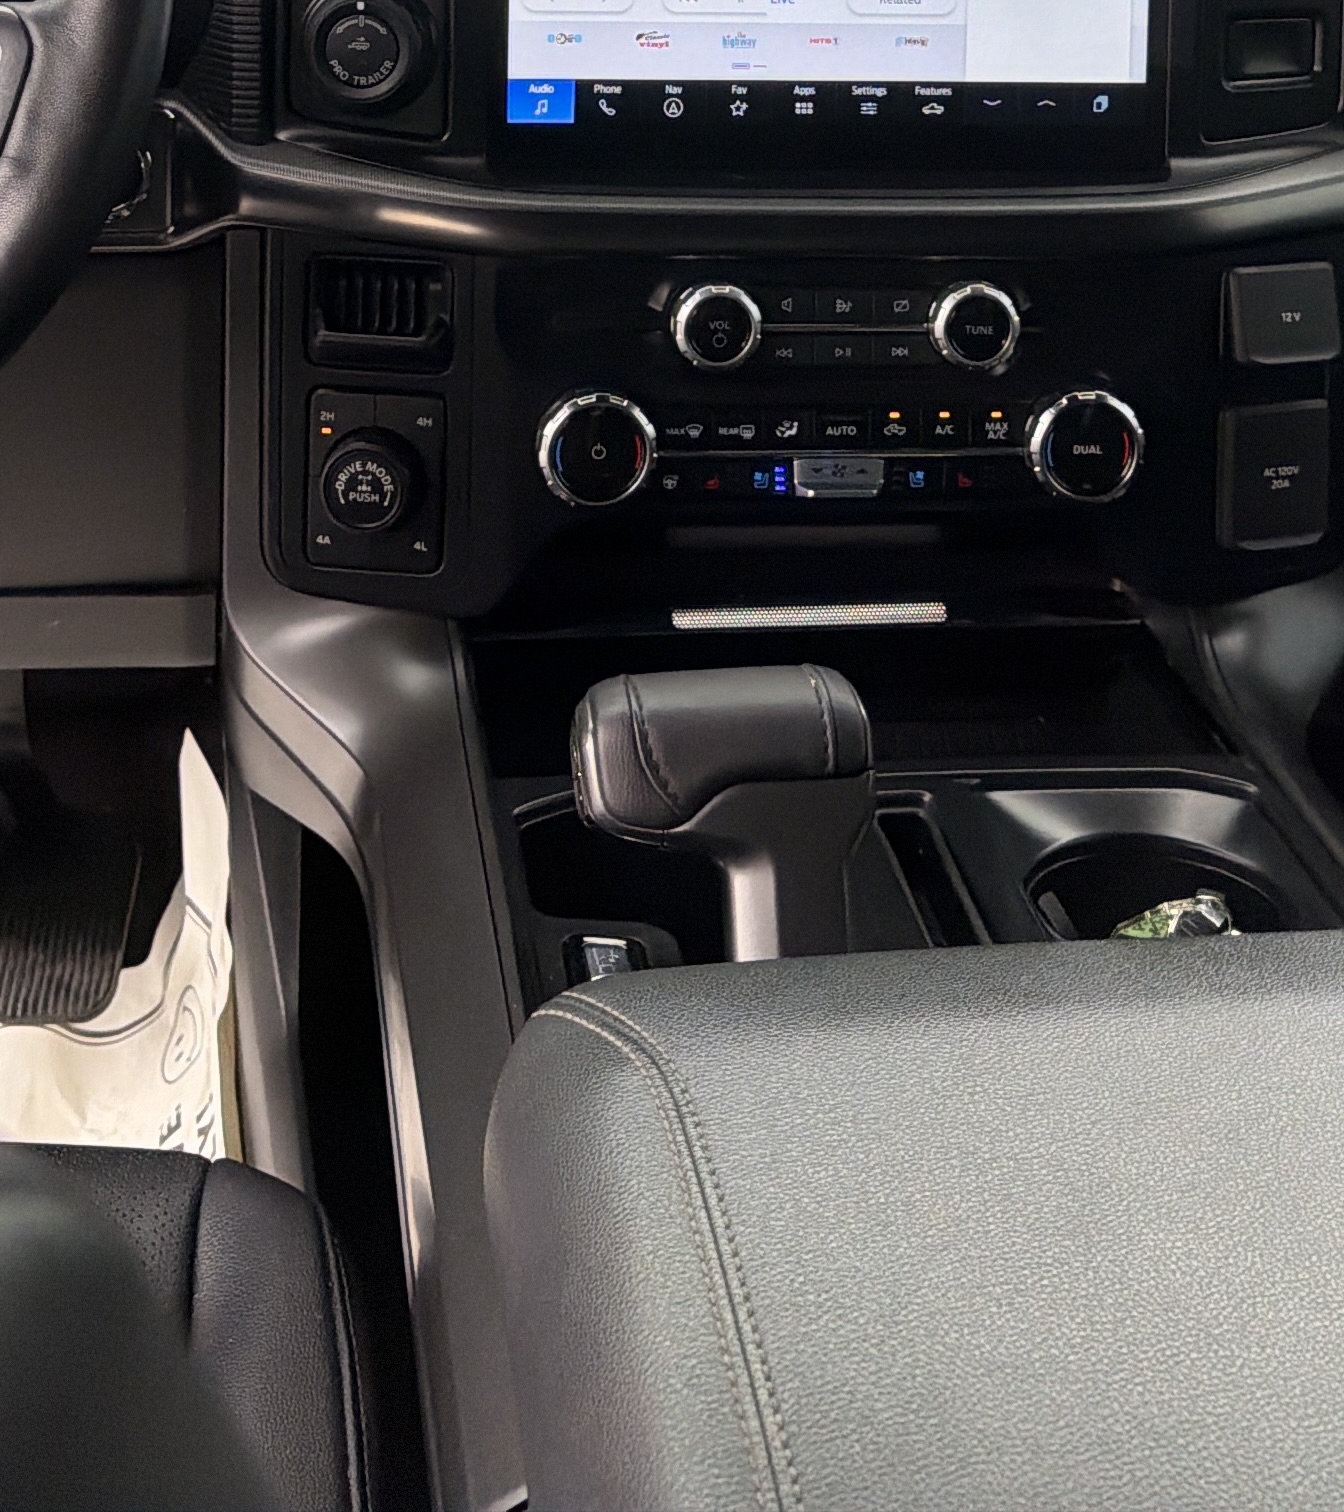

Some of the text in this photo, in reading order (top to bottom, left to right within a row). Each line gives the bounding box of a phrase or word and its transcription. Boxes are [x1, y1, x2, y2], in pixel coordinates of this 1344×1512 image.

[329, 59, 394, 86] PRO TRAILER
[528, 84, 554, 95] Audio
[594, 84, 622, 95] Phone
[665, 85, 683, 95] Nav
[731, 86, 747, 95] Fav
[793, 85, 815, 97] Apps
[851, 85, 887, 97] Settings
[915, 86, 952, 96] Features
[1281, 312, 1301, 322] 12 V
[709, 321, 730, 329] VOL
[965, 325, 993, 334] TUNE
[320, 410, 335, 421] 2H
[417, 417, 433, 427] 4H
[984, 421, 1009, 432] MAX
[665, 427, 686, 435] MAX
[718, 427, 740, 435] REAR
[826, 426, 856, 435] AUTO
[935, 425, 954, 434] A/C
[986, 430, 1007, 441] A/C
[1073, 445, 1102, 454] DUAL
[335, 461, 394, 492] DRIVE MODE
[1264, 466, 1300, 477] AC 120V
[1272, 479, 1290, 490] 20A
[349, 493, 380, 503] PUSH
[316, 535, 331, 545] 4A
[413, 541, 428, 552] 4L
